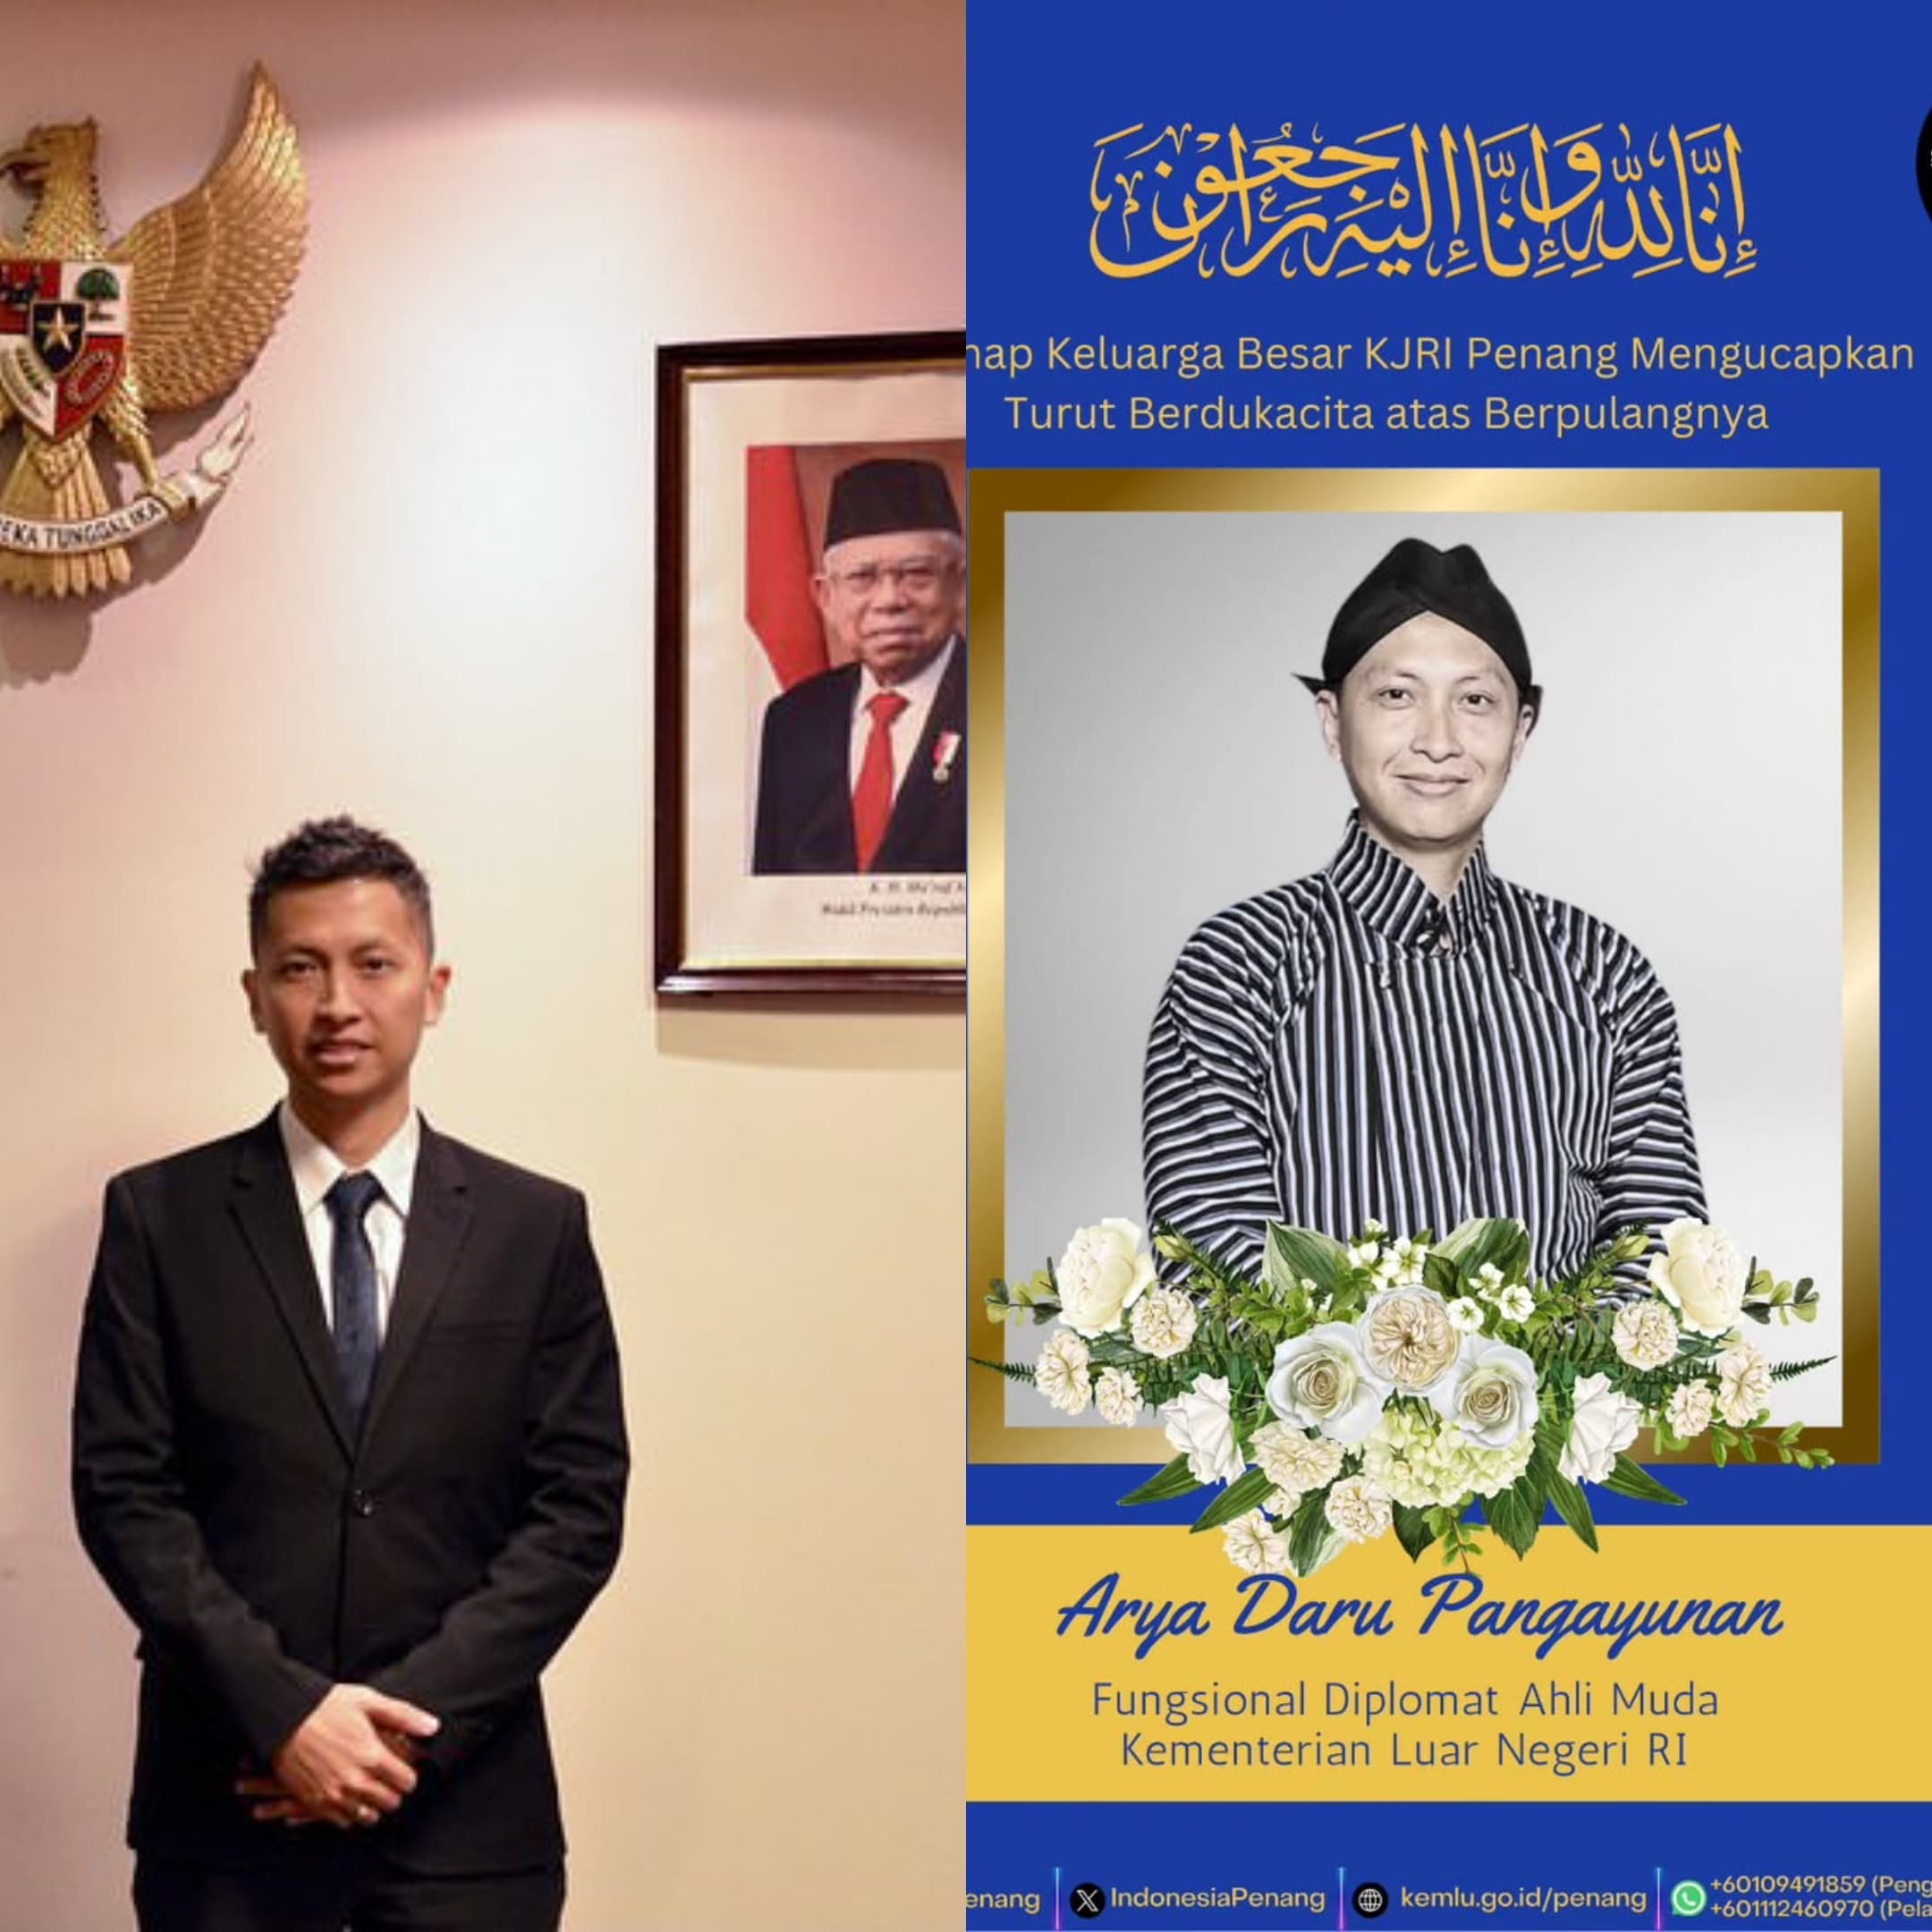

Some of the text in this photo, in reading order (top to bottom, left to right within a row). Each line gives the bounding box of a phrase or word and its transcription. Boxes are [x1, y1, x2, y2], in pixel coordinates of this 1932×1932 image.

[1047, 335, 1225, 380] Keluarga
[1238, 336, 1353, 372] Besar
[1365, 336, 1453, 372] KJRI
[1468, 336, 1620, 380] Penang
[1631, 335, 1915, 380] Mengucapkan
[1004, 395, 1770, 439] Turut Berdukacita atas Berpulangnya
[1056, 1572, 1785, 1661] Arya Daru Pangayunan
[1093, 1681, 1718, 1728] Fungsional Diplomat Ahli Muda
[1123, 1732, 1687, 1778] Kementerian Luar Negeri RI
[1111, 1886, 1326, 1915] IndonesiaPenang
[1401, 1886, 1648, 1915] kemlu.go.id/penang
[1710, 1876, 1867, 1894] +60109491859
[1710, 1900, 1875, 1918] +601112460970
